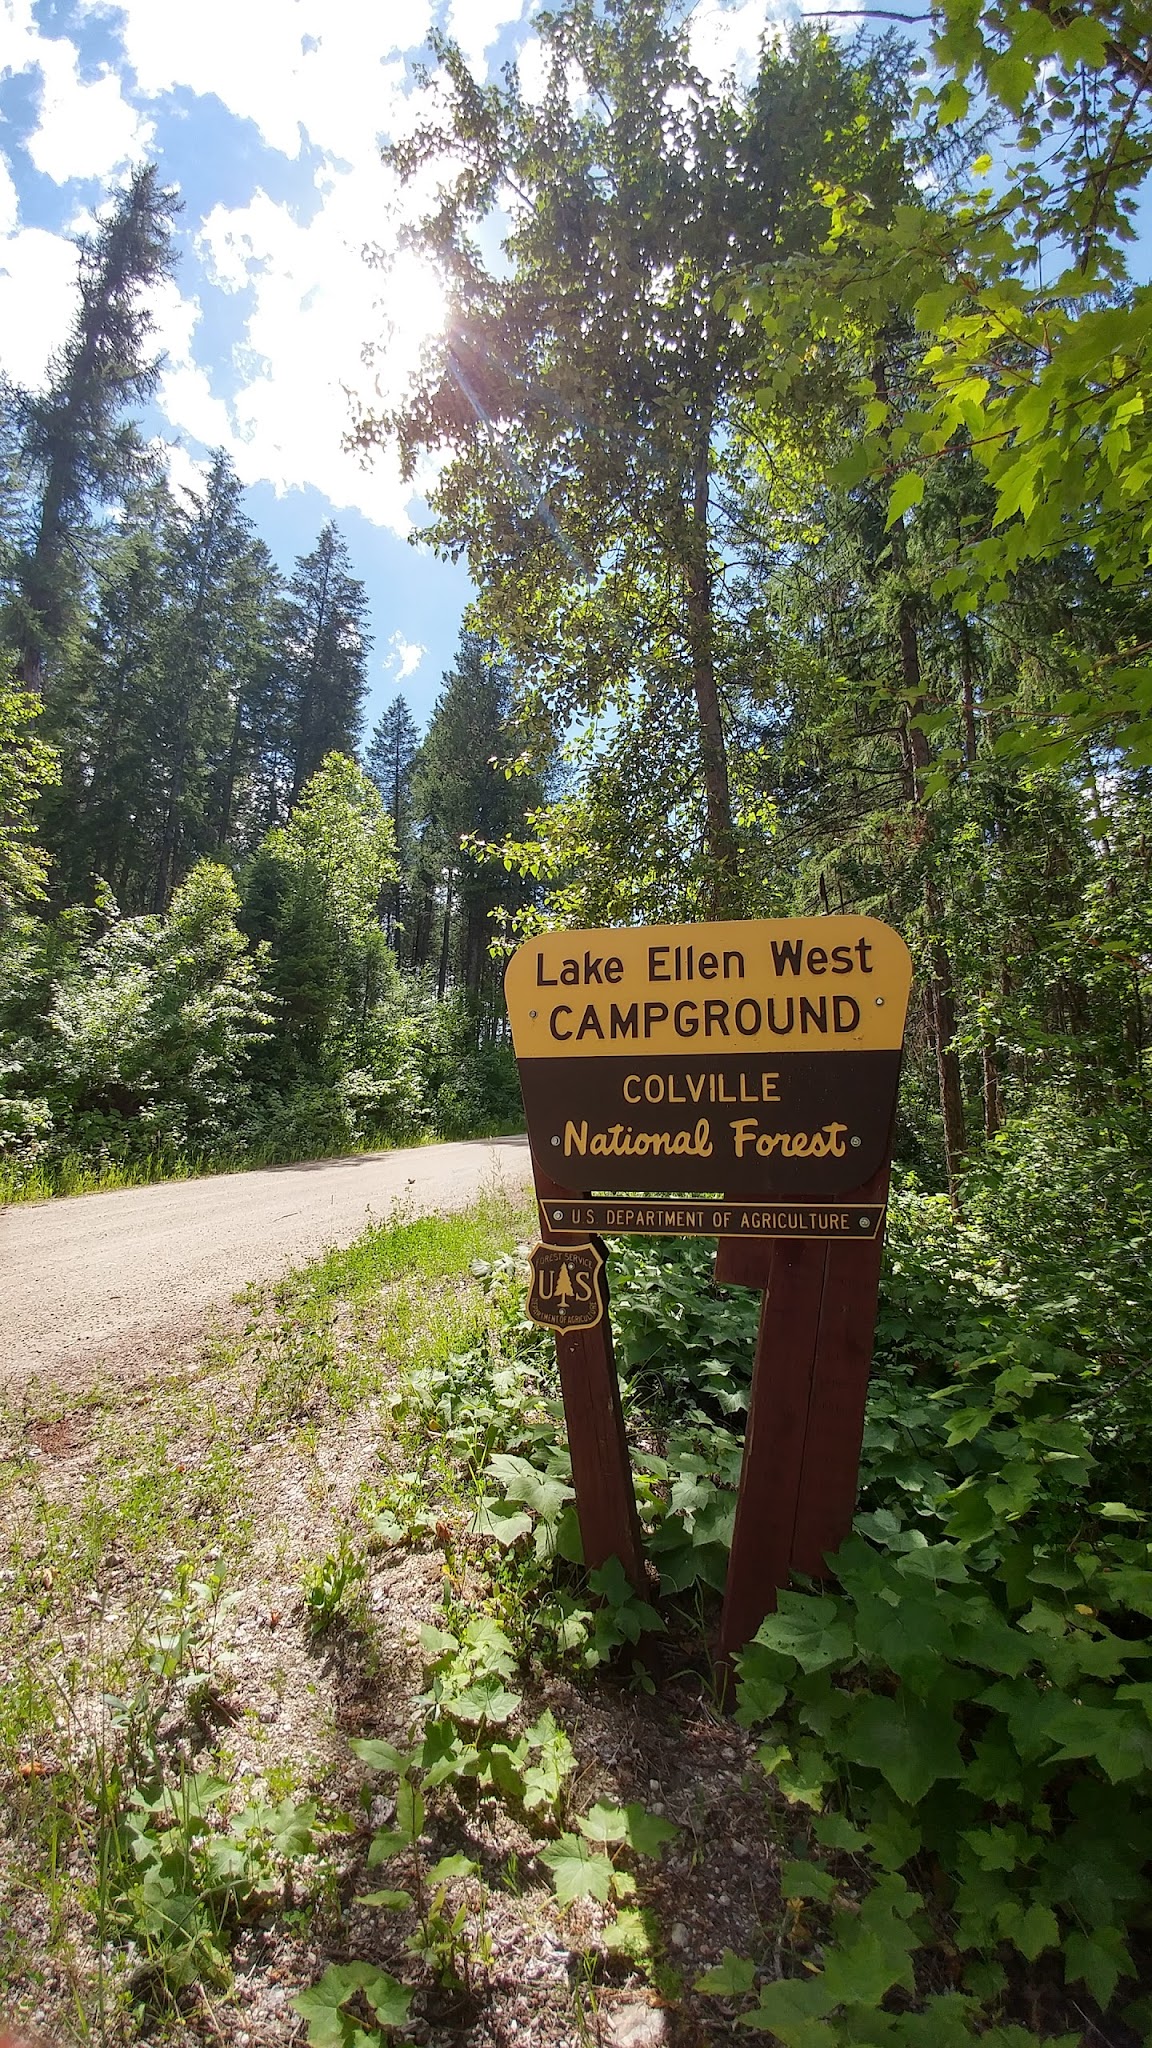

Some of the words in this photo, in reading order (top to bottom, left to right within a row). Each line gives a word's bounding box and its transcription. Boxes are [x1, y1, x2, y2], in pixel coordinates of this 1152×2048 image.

[536, 950, 624, 987] Lake
[648, 945, 745, 982] Ellen
[770, 937, 874, 977] West
[549, 995, 861, 1041] CAMPGROUND
[623, 1072, 781, 1104] COLVILLE
[564, 1118, 713, 1157] National
[729, 1118, 848, 1158] Forest
[607, 1209, 705, 1228] DEPARTMENT
[712, 1211, 732, 1228] OF
[740, 1212, 850, 1230] AGRICULTURE
[535, 1253, 562, 1268] FOREST
[564, 1253, 593, 1270] SERVICE
